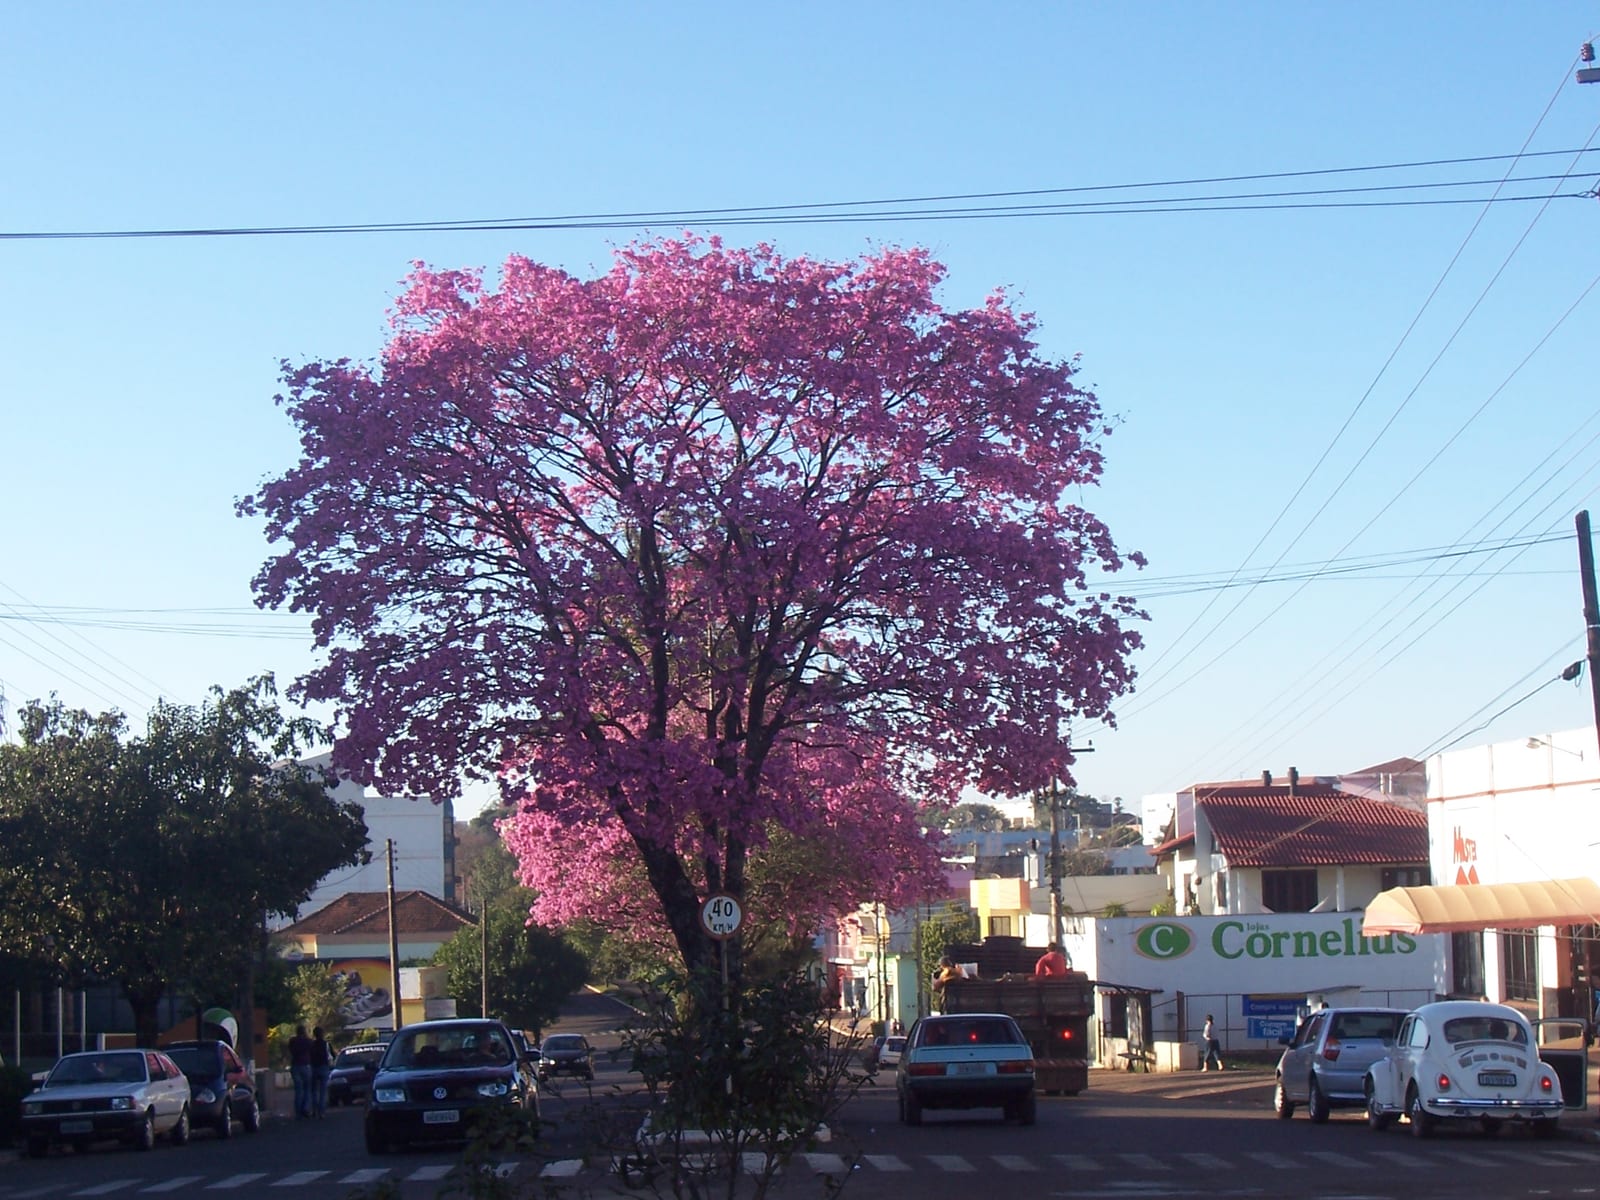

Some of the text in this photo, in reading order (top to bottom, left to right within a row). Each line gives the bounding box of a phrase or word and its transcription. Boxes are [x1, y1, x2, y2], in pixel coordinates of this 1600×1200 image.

[712, 900, 733, 917] 40
[1247, 922, 1270, 932] lojas
[1150, 925, 1175, 956] C
